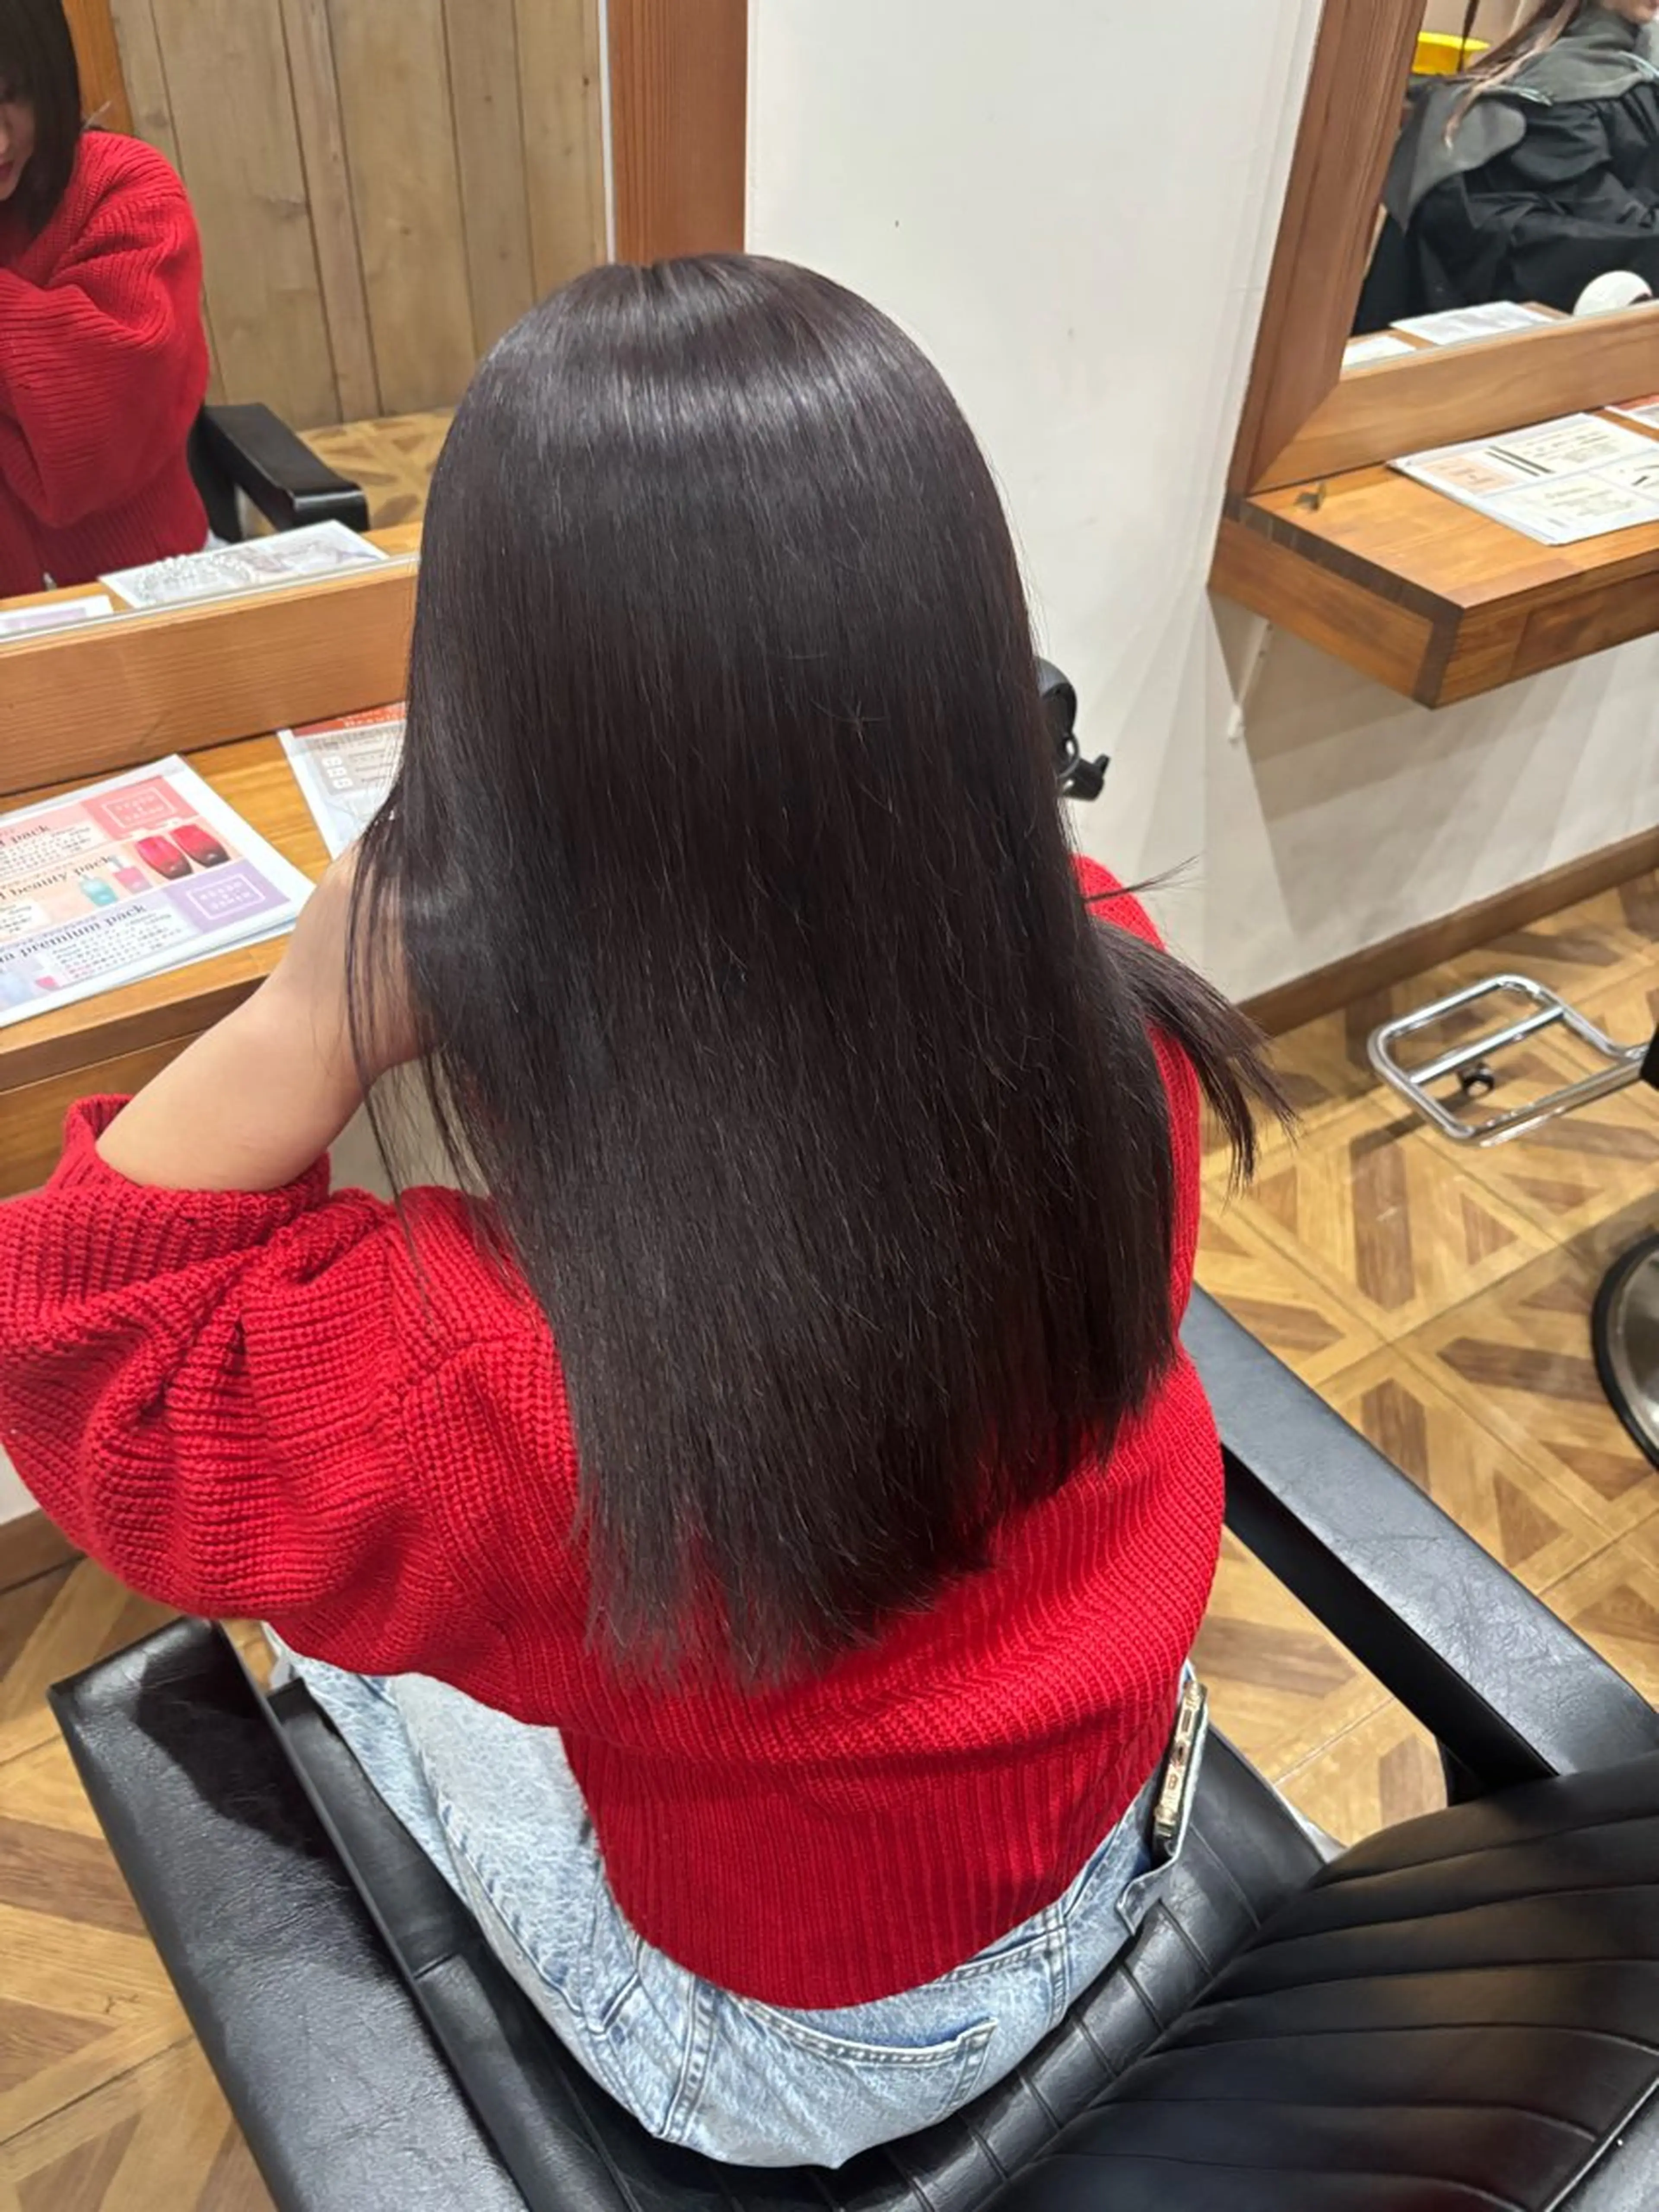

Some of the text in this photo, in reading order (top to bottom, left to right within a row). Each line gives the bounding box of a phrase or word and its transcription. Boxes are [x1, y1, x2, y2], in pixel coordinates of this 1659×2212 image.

[9, 872, 67, 896] beauty
[20, 921, 102, 957] premium
[104, 904, 147, 926] pack
